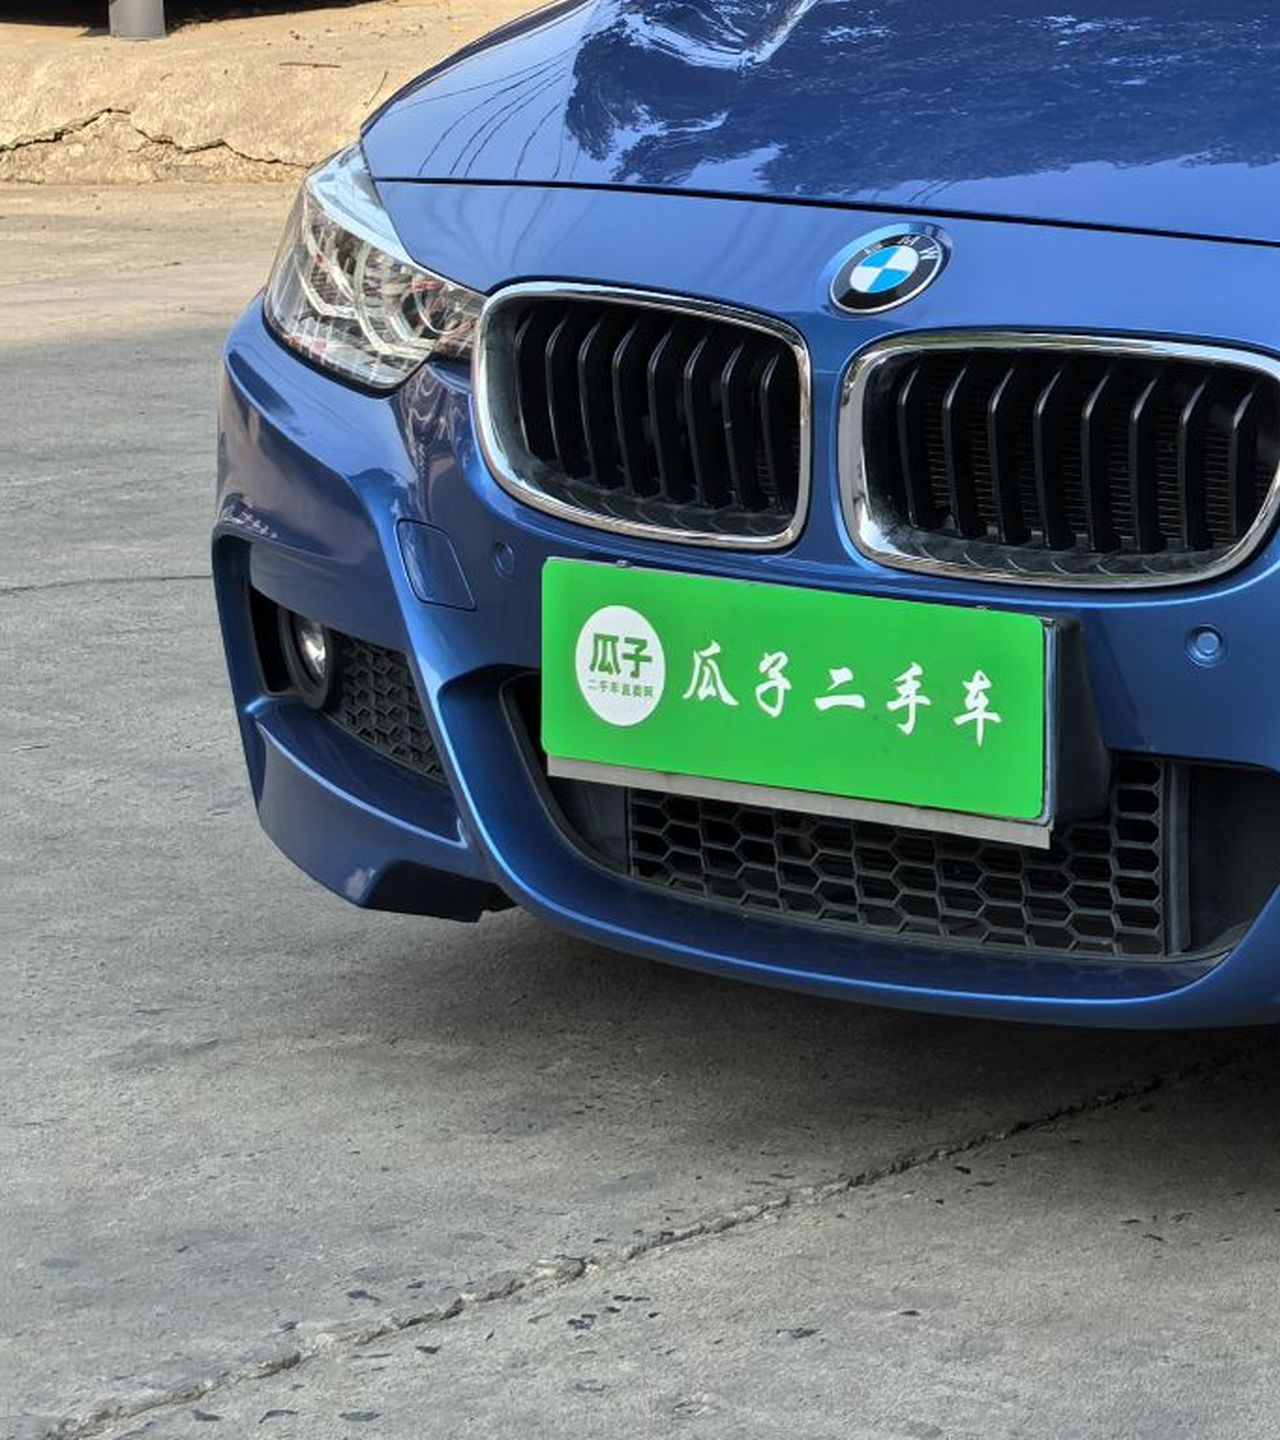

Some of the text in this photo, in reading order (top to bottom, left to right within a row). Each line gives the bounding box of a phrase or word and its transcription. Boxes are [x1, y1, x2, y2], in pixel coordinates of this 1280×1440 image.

[589, 633, 653, 679] 瓜子
[682, 640, 1002, 747] 瓜子二手车
